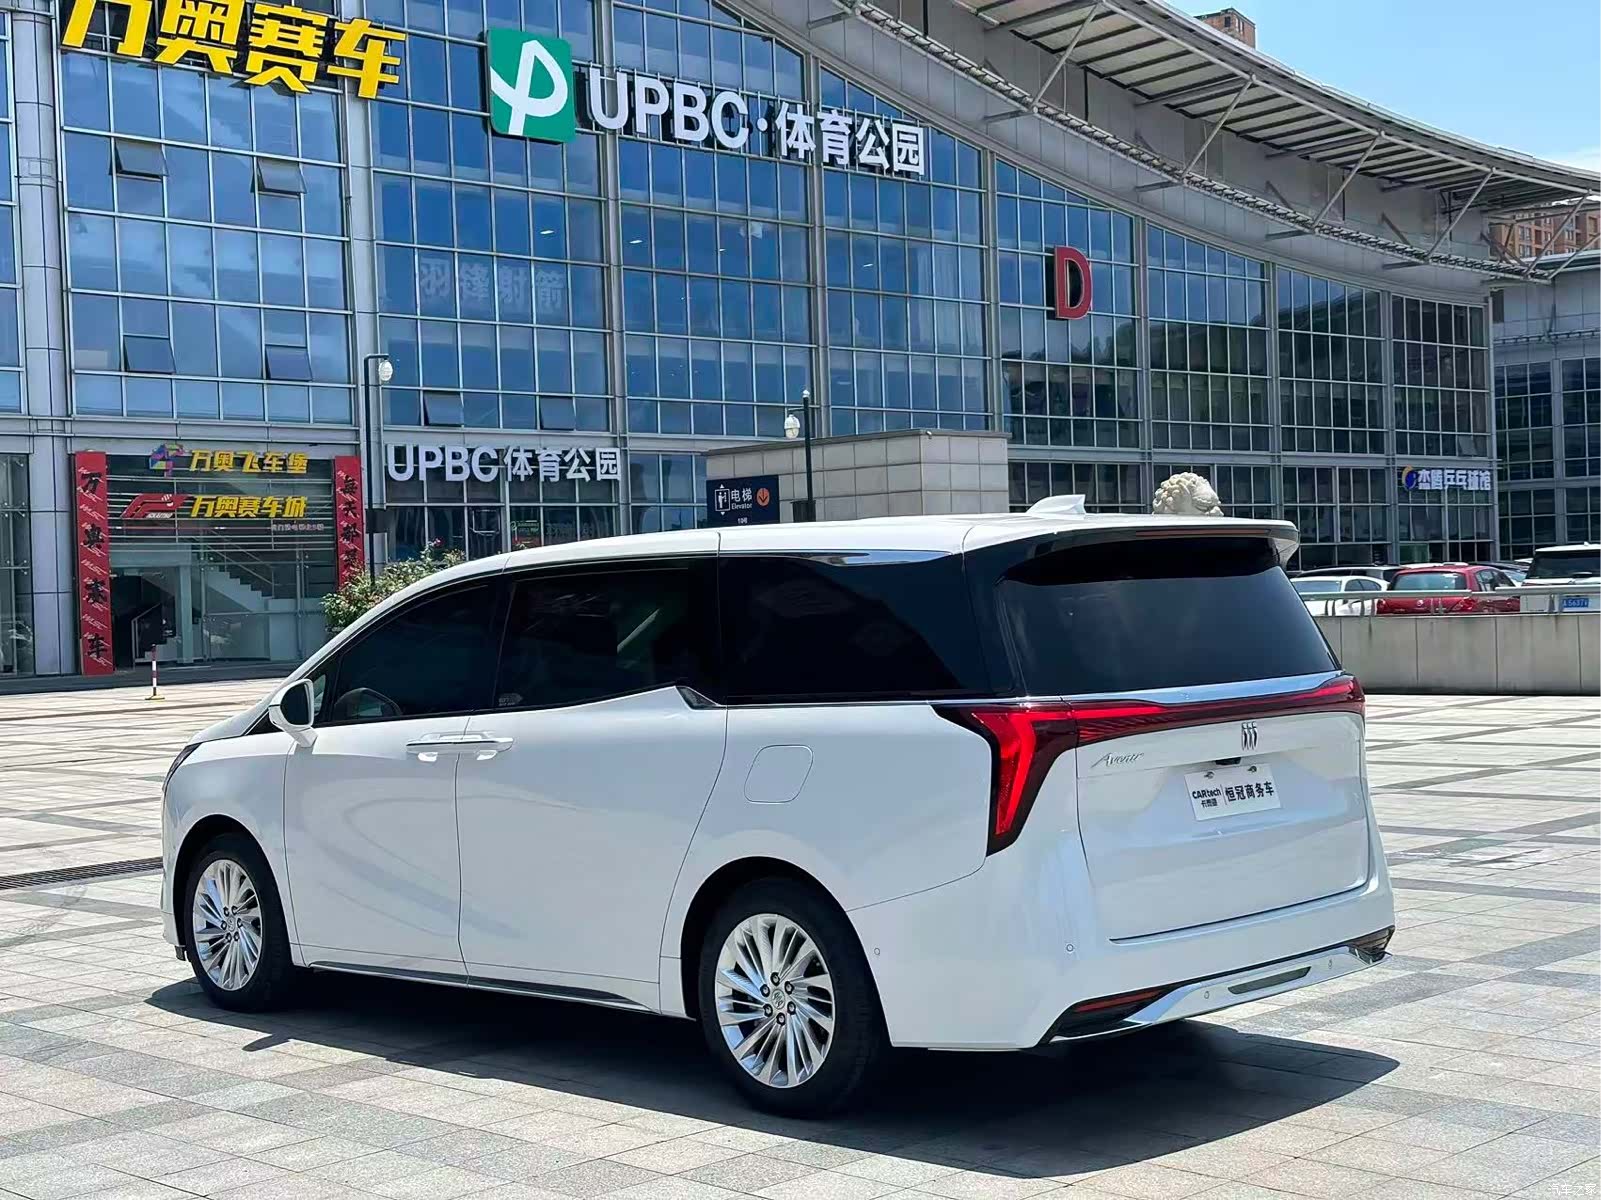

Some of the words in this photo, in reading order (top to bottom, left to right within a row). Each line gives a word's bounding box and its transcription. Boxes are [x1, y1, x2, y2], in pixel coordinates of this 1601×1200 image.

[1054, 245, 1093, 320] D
[189, 450, 309, 474] 万奥飞车堡
[731, 487, 753, 502] 电梯
[190, 495, 309, 518] 万奥赛车城
[731, 502, 753, 510] Elevator
[1192, 787, 1222, 799] CARtech
[1225, 781, 1275, 802] 恒冠商务车
